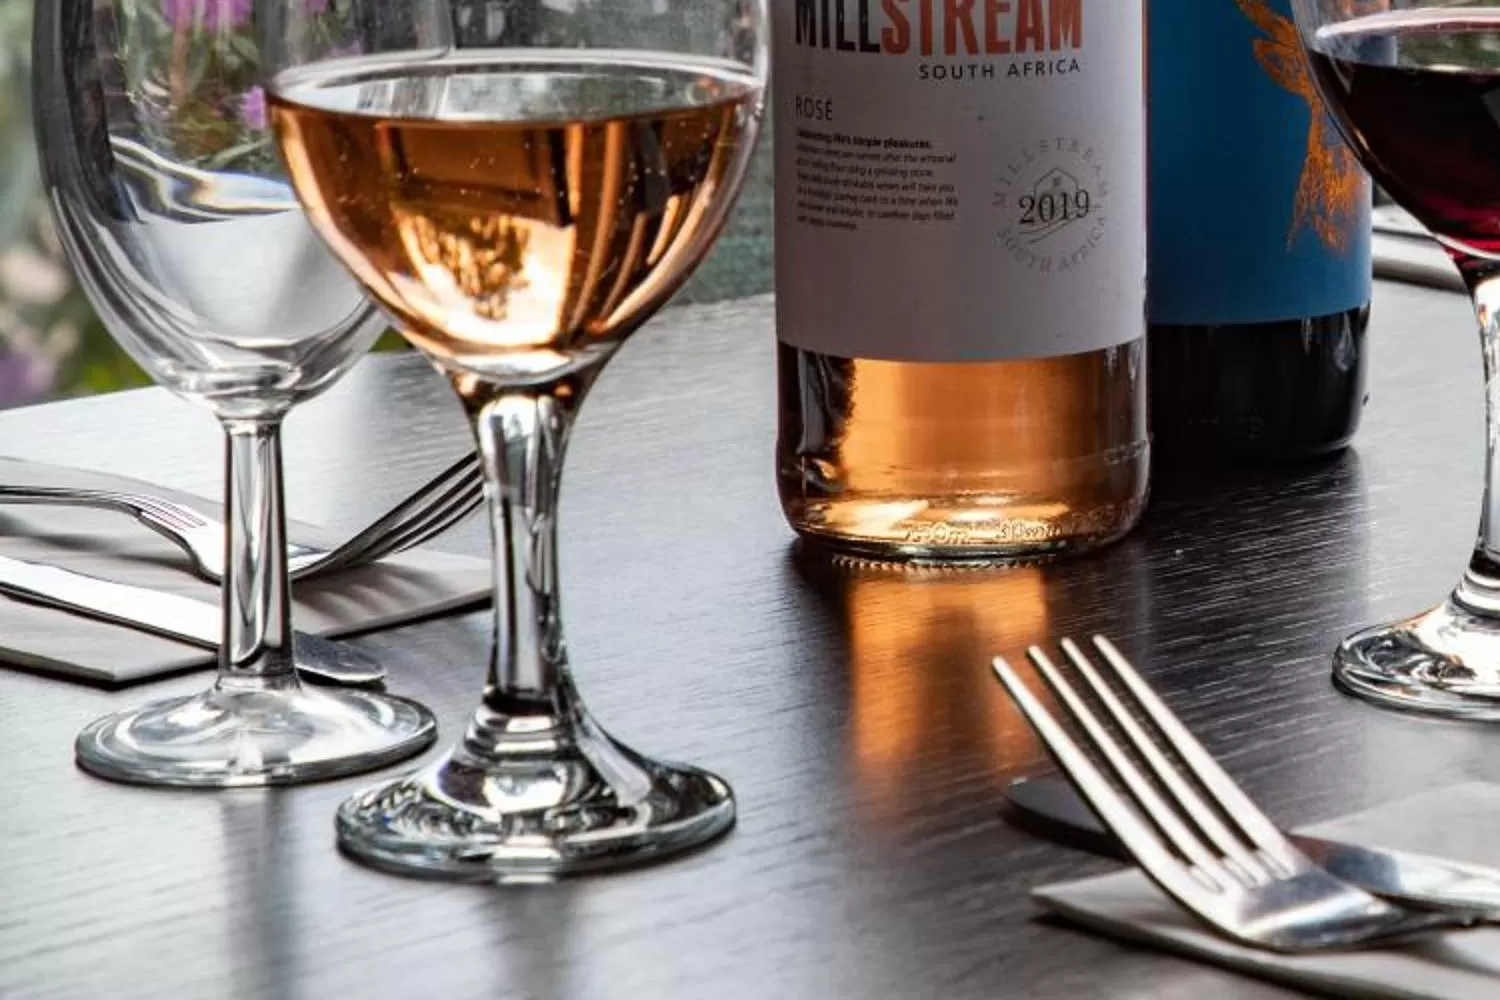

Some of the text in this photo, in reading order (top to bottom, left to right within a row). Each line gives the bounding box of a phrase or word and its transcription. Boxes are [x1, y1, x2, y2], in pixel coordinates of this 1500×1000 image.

[918, 59, 1082, 80] SOUTH AFRICA
[1018, 189, 1090, 225] 2019
